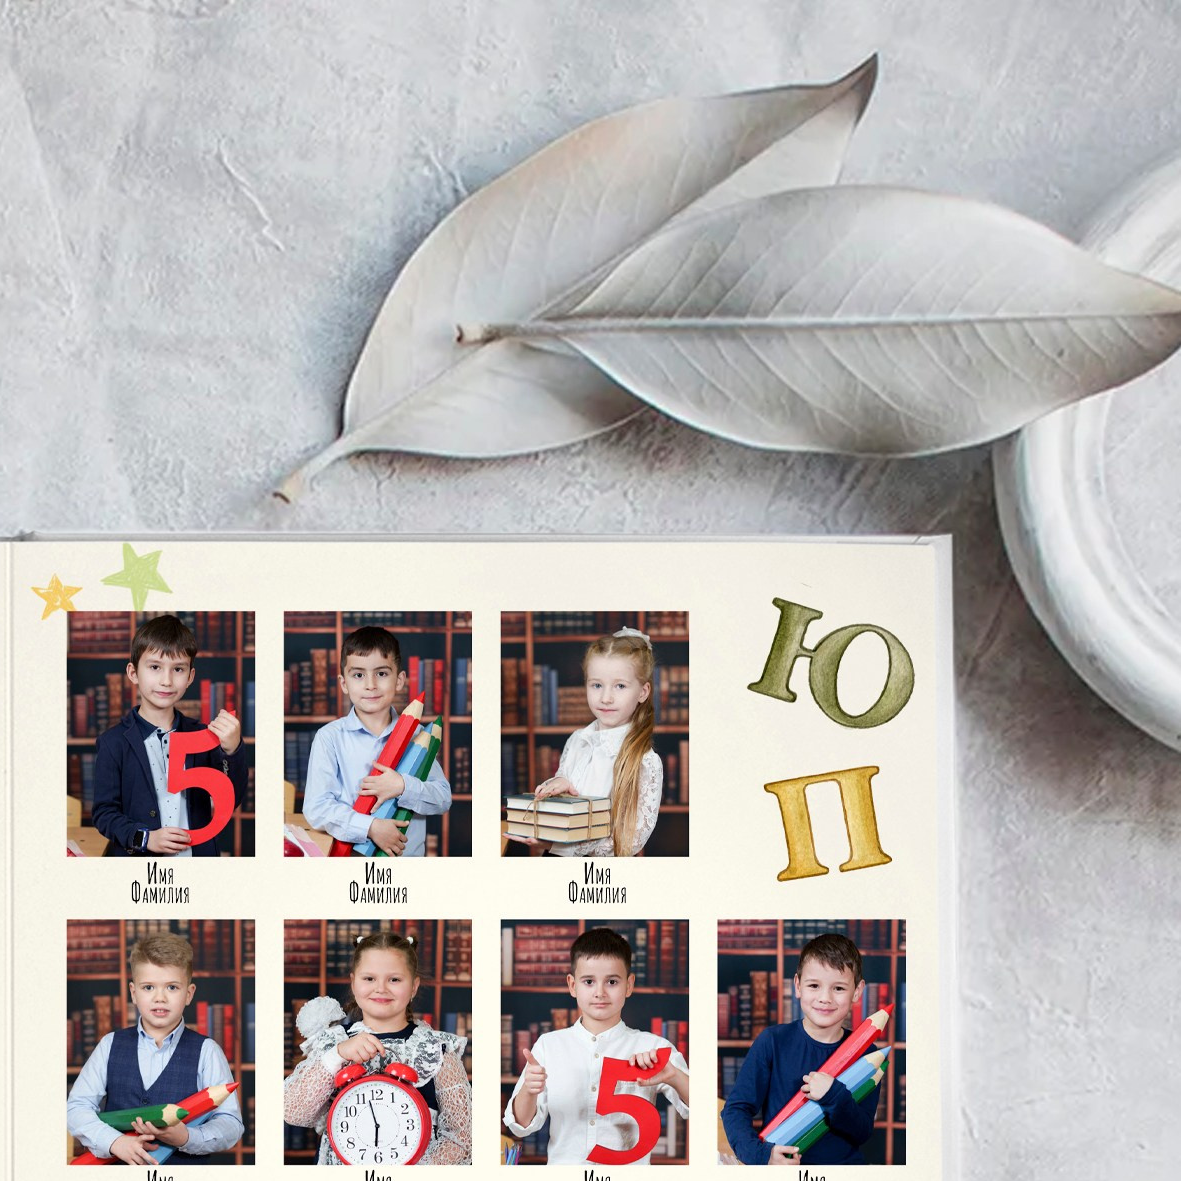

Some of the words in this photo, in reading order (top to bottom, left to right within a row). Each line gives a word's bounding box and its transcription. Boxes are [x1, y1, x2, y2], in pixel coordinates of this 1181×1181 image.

[747, 597, 915, 729] Ю
[167, 710, 235, 846] 5
[764, 766, 893, 882] П
[147, 861, 174, 885] Имя
[365, 861, 392, 885] Имя
[584, 861, 611, 885] Имя
[131, 879, 190, 905] Фамилия
[349, 879, 408, 905] Фамилия
[568, 880, 627, 905] Фамилия
[356, 1093, 367, 1105] 11
[371, 1089, 383, 1101] 12
[390, 1092, 395, 1104] 1
[345, 1106, 357, 1118] 10
[401, 1103, 409, 1115] 2
[586, 1047, 672, 1165] 5
[340, 1121, 349, 1133] 9
[407, 1118, 415, 1131] 3
[346, 1137, 355, 1149] 8
[401, 1135, 408, 1146] 4
[359, 1148, 367, 1160] 7
[374, 1152, 383, 1164] 6
[391, 1148, 399, 1160] 5
